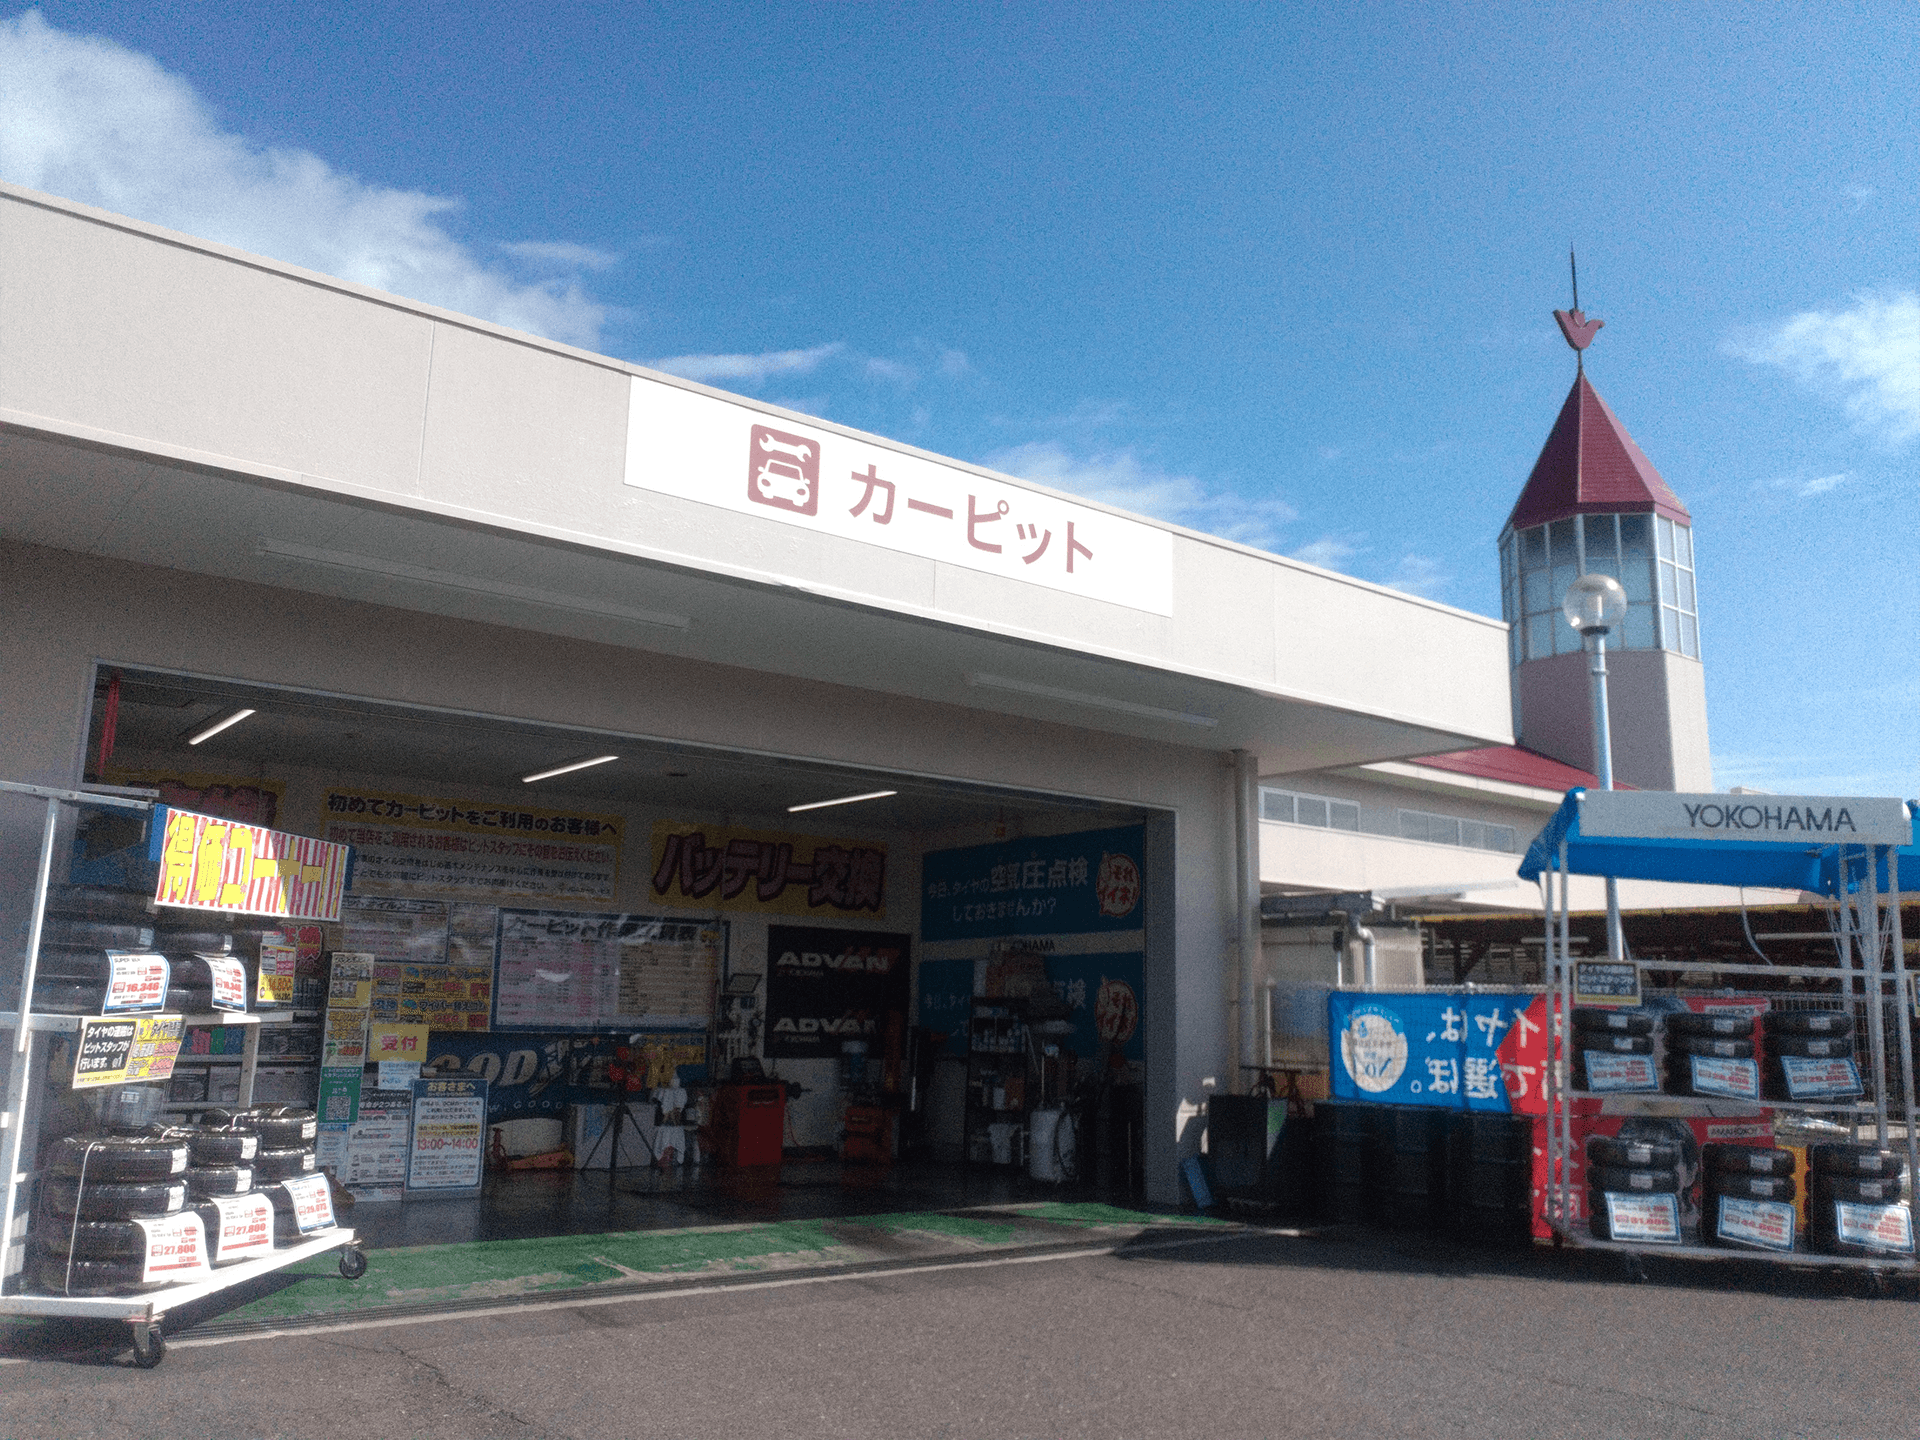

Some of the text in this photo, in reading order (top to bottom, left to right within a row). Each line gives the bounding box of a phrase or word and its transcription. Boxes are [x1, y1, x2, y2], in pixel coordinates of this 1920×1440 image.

[848, 464, 1093, 573] カーピット
[328, 793, 618, 836] 初めてカーピットをご利用のお客様へ
[1684, 803, 1857, 832] YOKOHAMA
[653, 832, 886, 912] バッテリー交換
[777, 950, 889, 970] ADVAN
[381, 1035, 418, 1051] 受付
